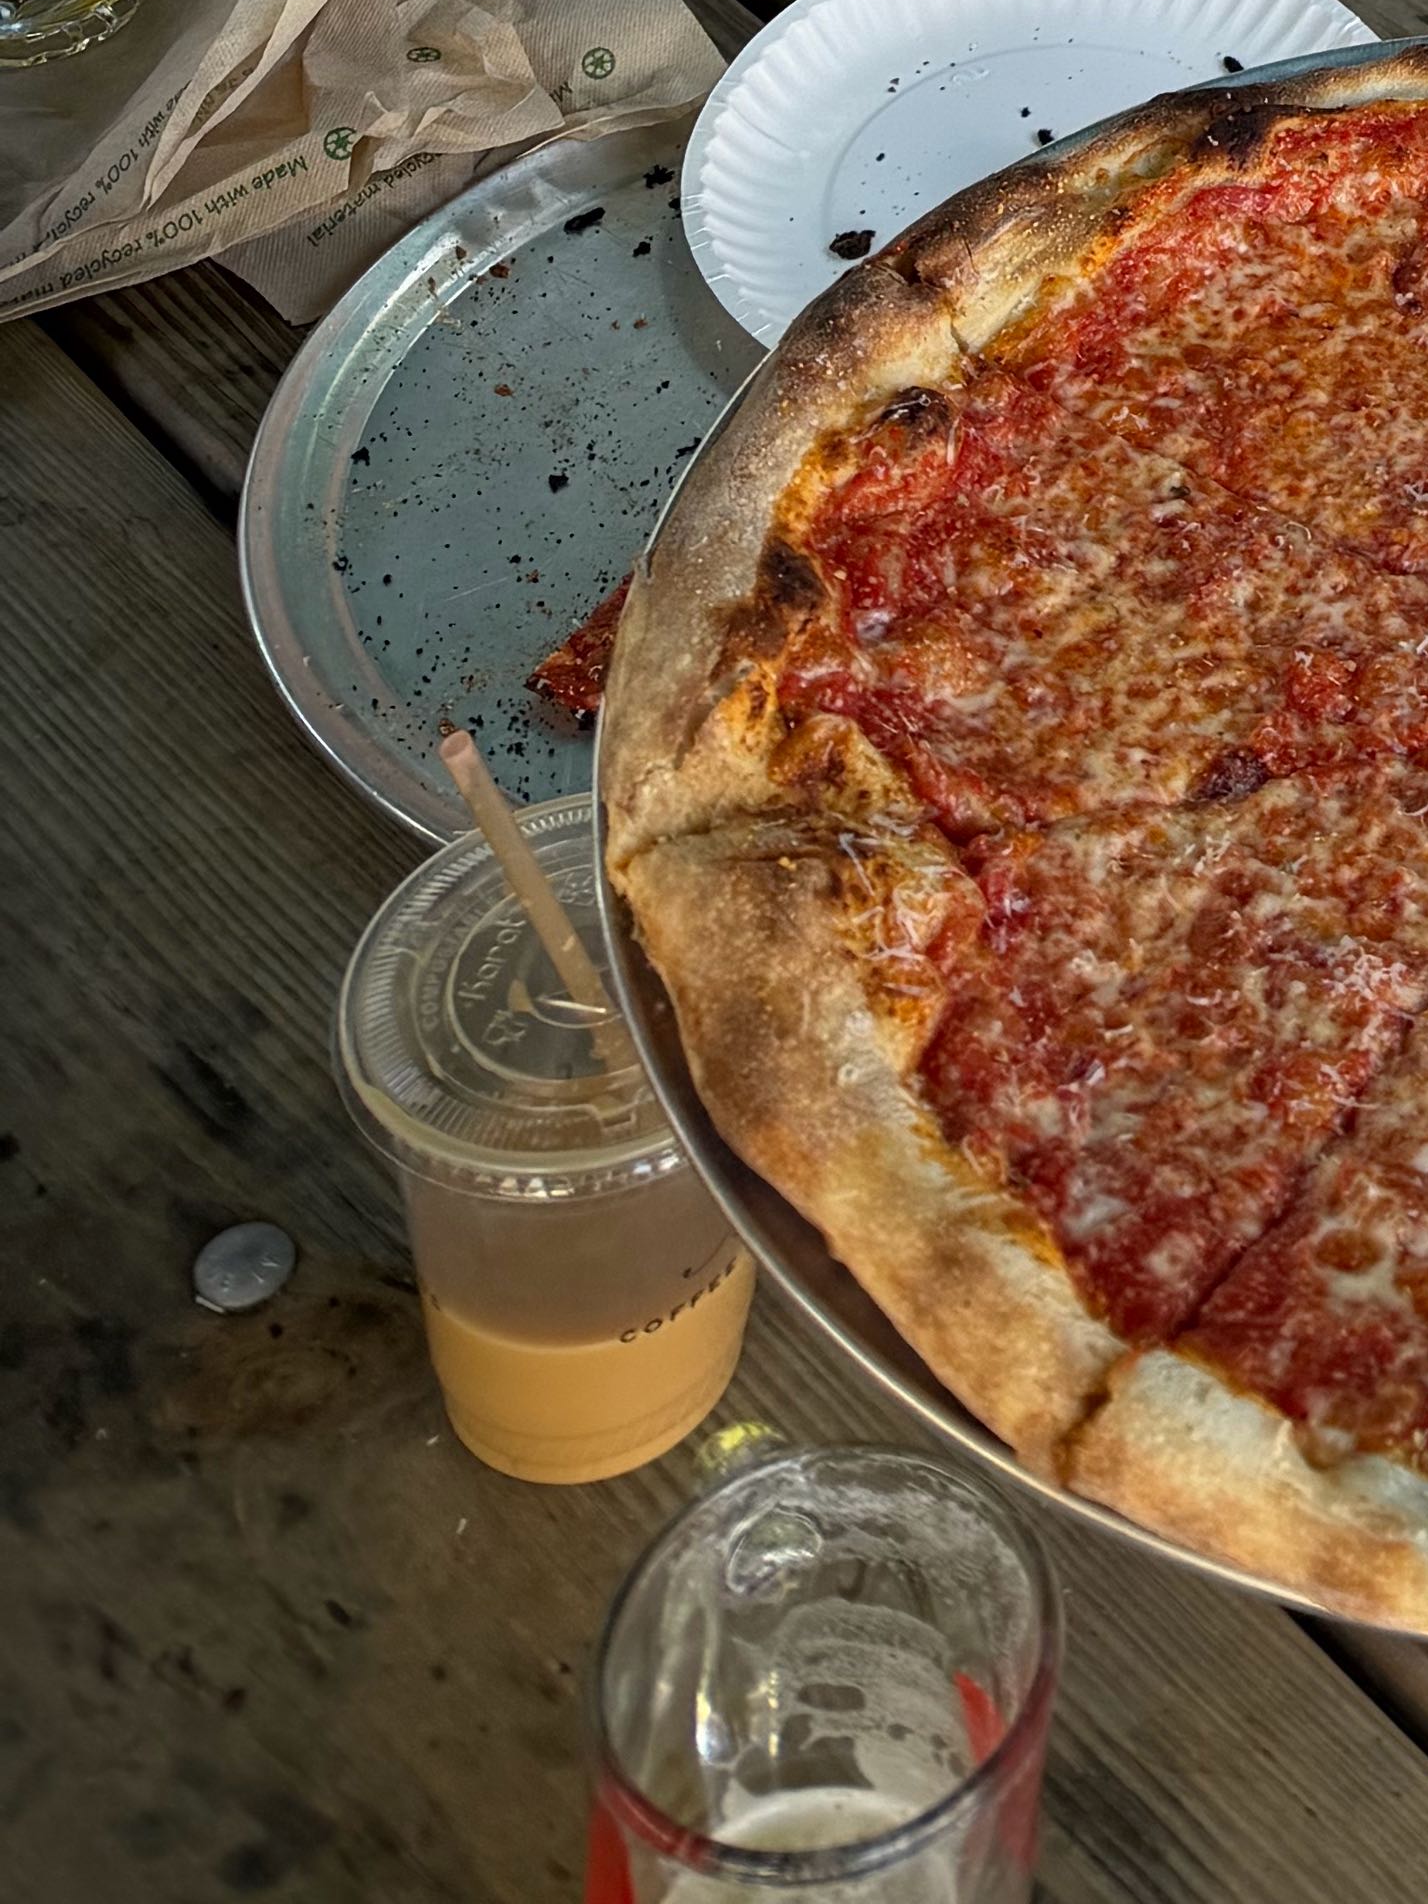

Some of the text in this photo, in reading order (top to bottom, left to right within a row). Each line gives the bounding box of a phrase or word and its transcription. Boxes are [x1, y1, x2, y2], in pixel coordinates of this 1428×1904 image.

[138, 110, 166, 149] with
[95, 147, 139, 195] 100%
[252, 155, 309, 191] Made
[203, 181, 249, 217] with
[306, 175, 379, 248] material
[144, 206, 204, 249] 100%
[58, 231, 145, 289] recycled
[619, 1256, 738, 1344] COFFEE
